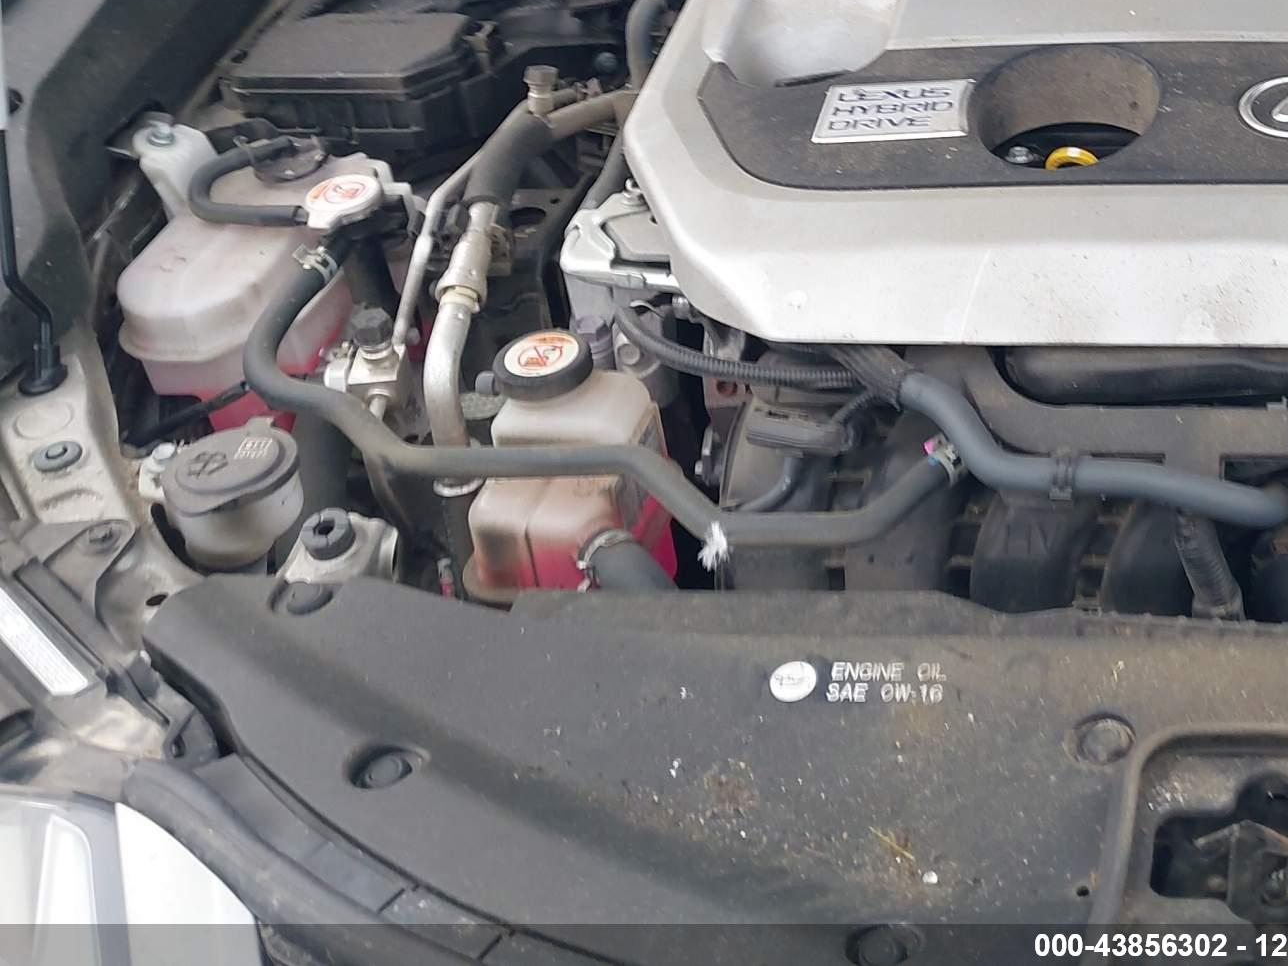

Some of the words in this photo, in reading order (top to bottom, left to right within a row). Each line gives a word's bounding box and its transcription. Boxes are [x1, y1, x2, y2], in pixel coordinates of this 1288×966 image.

[838, 87, 952, 102] LEXUS
[832, 101, 954, 116] HYBRID
[828, 116, 933, 131] DRIVE
[831, 661, 905, 682] ENGINE
[918, 662, 947, 682] OIL
[826, 682, 869, 703] SAE
